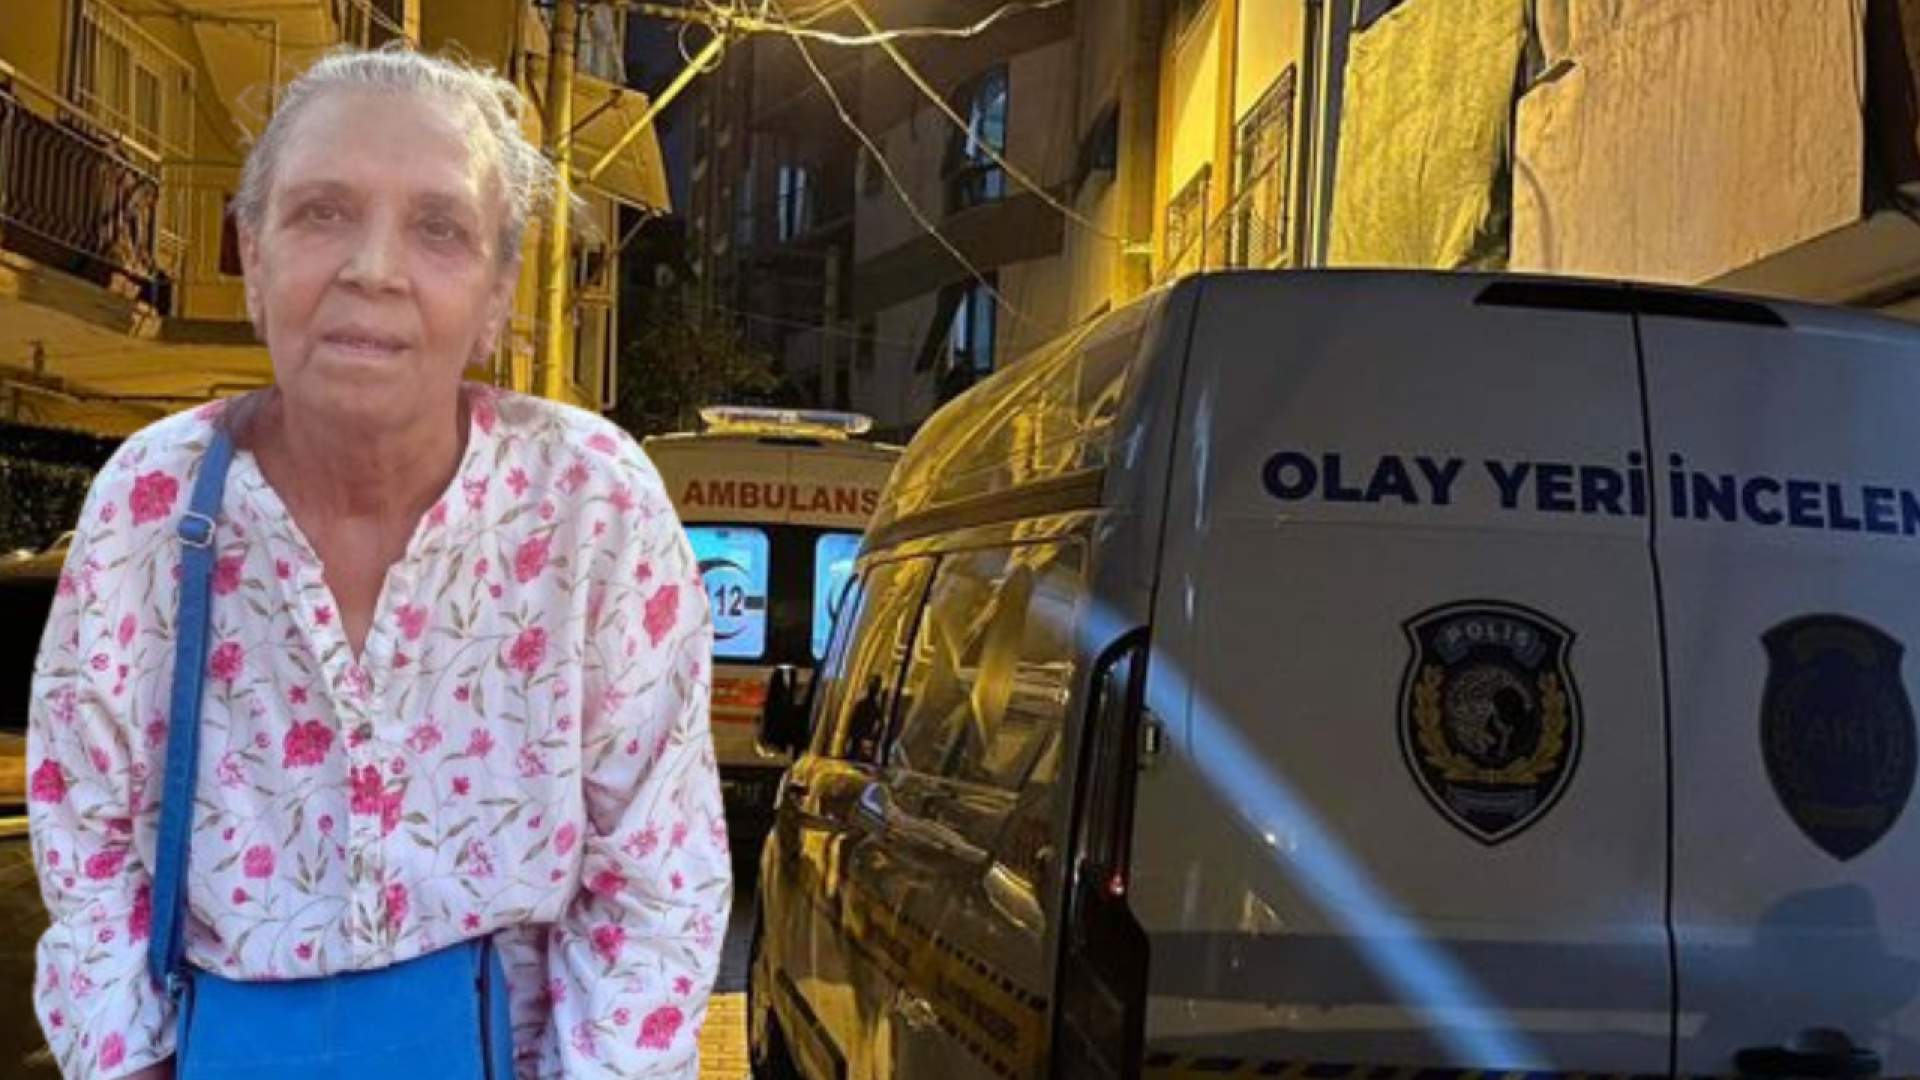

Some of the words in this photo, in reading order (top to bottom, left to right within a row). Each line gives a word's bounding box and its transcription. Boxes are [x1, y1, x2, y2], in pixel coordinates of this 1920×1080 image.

[681, 479, 880, 516] AMBULANS
[1261, 451, 1464, 505] OLAY
[1484, 450, 1646, 517] YERİ
